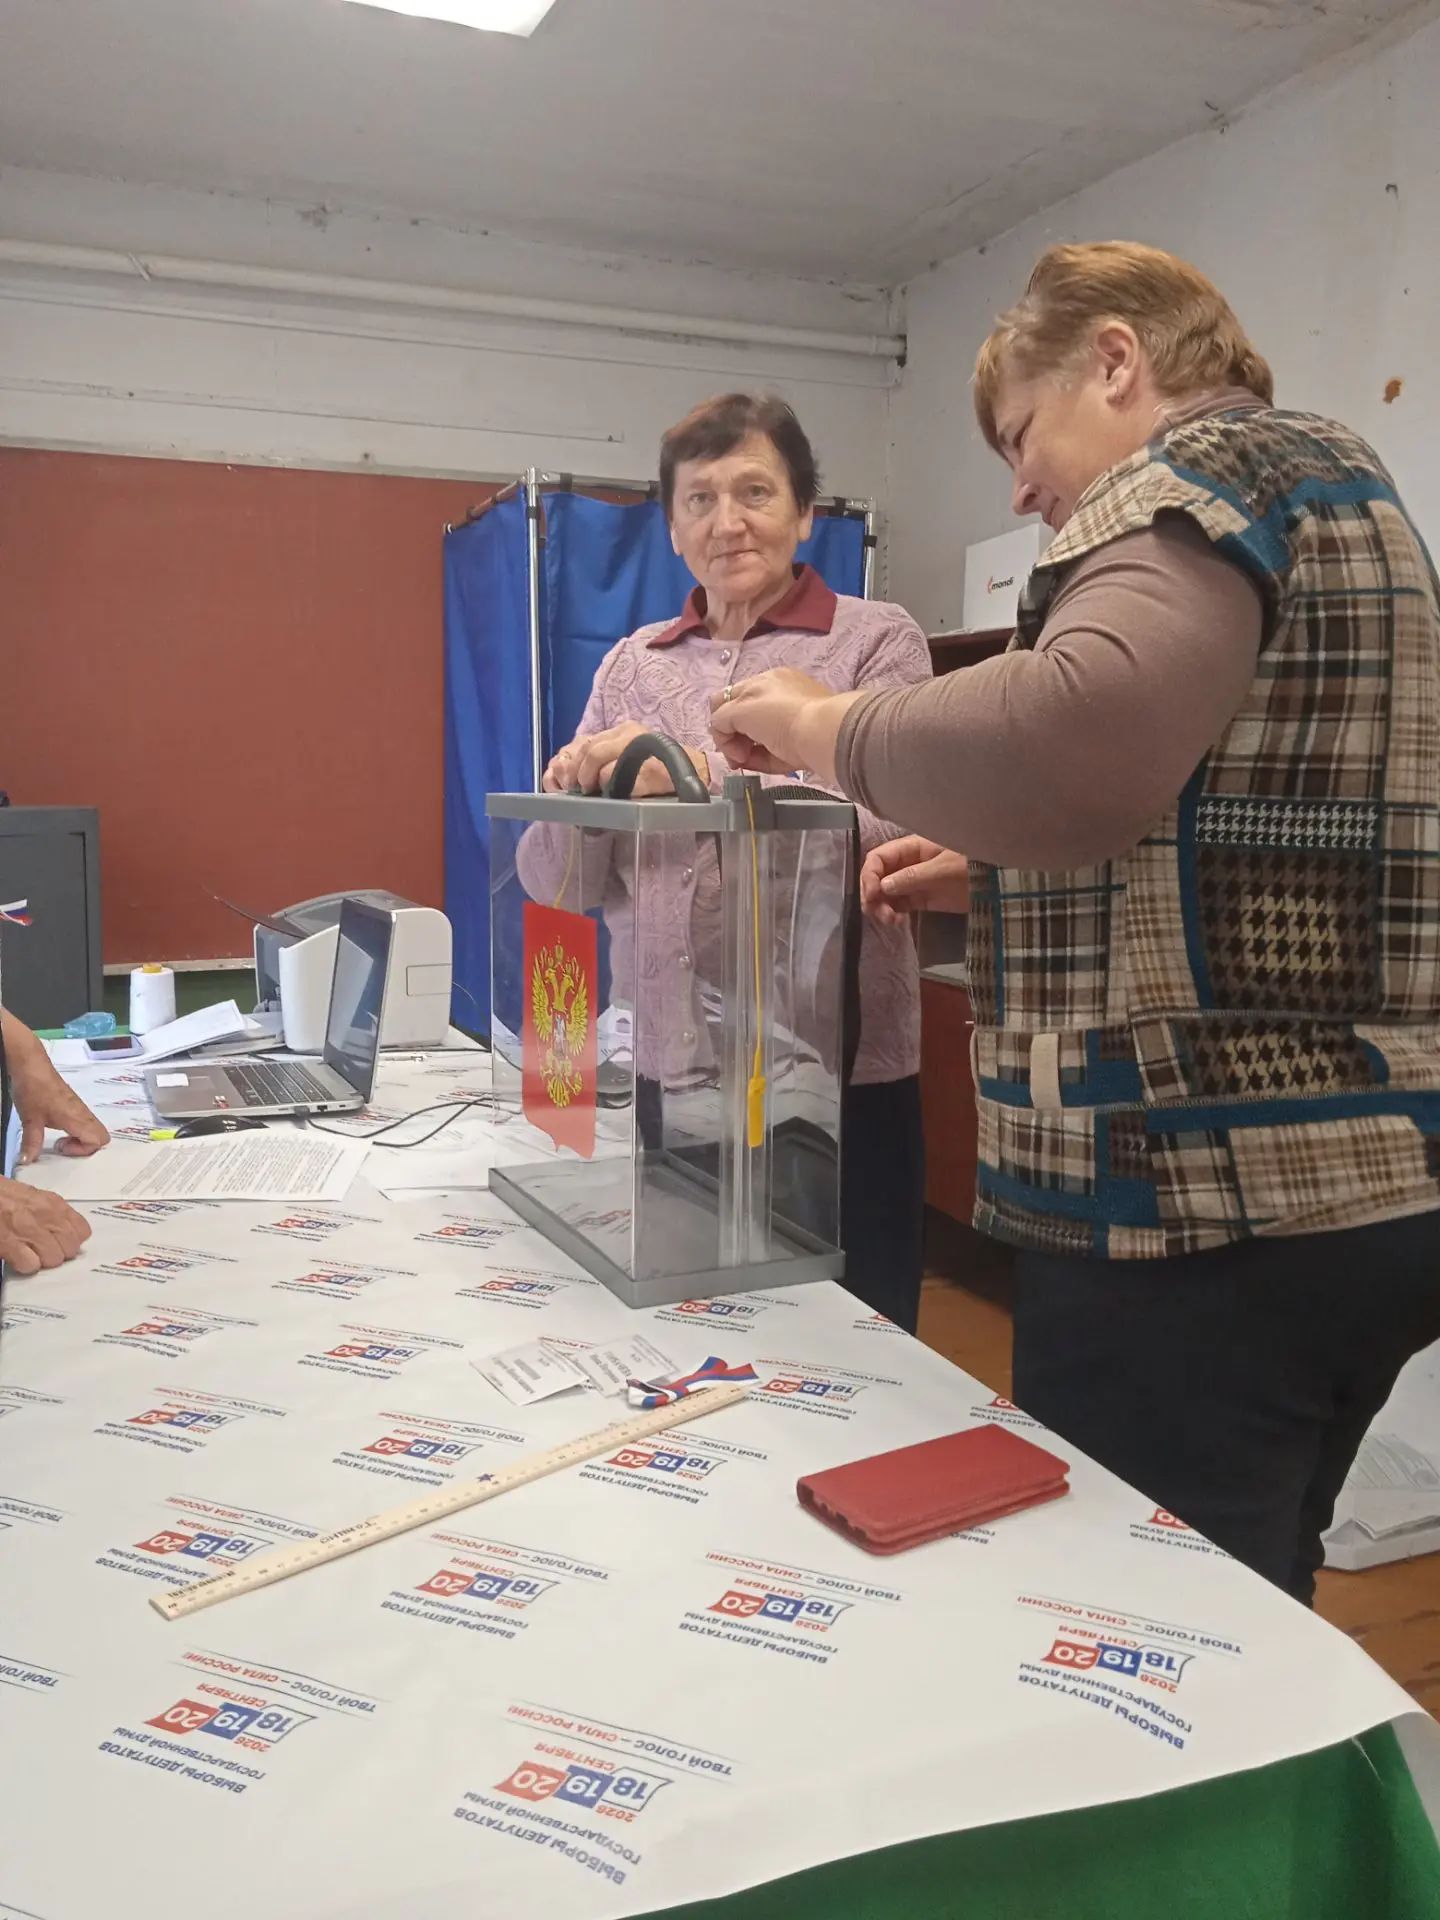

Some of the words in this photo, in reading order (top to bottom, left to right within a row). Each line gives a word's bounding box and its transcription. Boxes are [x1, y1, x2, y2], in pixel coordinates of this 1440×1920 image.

[991, 577, 1014, 590] mondi
[486, 1545, 519, 1557] СИЛА
[450, 1557, 514, 1577] СЕНТЯБРЯ
[530, 1556, 573, 1570] ГОЛОС
[766, 1566, 802, 1579] СИЛА
[574, 1566, 608, 1580] ТВОЙ
[430, 1576, 468, 1592] 20
[473, 1579, 502, 1594] 19
[510, 1580, 539, 1595] 18
[734, 1578, 804, 1598] СЕНТЯБРЯ
[816, 1578, 862, 1592] ГОЛОС
[389, 1591, 424, 1603] ДУМЫ
[864, 1588, 901, 1601] ТВОЙ
[380, 1601, 458, 1624] ДЕПУТАТОВ
[722, 1596, 760, 1613] 20
[766, 1600, 795, 1615] 19
[805, 1601, 834, 1617] 18
[1087, 1611, 1127, 1626] СИЛА
[456, 1620, 516, 1639] ВЫБОРЫ
[679, 1623, 763, 1646] ДЕПУТАТОВ
[1058, 1625, 1138, 1648] СЕНТЯБРЯ
[1145, 1624, 1196, 1641] ГОЛОС
[763, 1642, 828, 1664] ВЫБОРЫ
[1199, 1637, 1241, 1654] ТВОЙ
[182, 1653, 241, 1673] РОССИИ!
[1054, 1646, 1094, 1665] 20
[1103, 1650, 1134, 1668] 19
[1145, 1652, 1177, 1671] 18
[20, 1671, 60, 1687] ТВОЙ
[242, 1668, 279, 1682] СИЛА
[1020, 1663, 1061, 1677] ДУМЫ
[196, 1683, 267, 1707] СЕНТЯБРЯ
[290, 1681, 339, 1701] ГОЛОС
[1018, 1675, 1113, 1709] ДЕПУТАТОВ
[337, 1696, 376, 1713] ТВОЙ
[164, 1707, 209, 1728] 20
[213, 1711, 248, 1730] 19
[256, 1712, 293, 1732] 18
[508, 1706, 574, 1729] РОССИИ!
[1115, 1704, 1184, 1749] ВЫБОРЫ
[112, 1727, 152, 1743] ДУМЫ
[577, 1724, 618, 1742] СИЛА
[98, 1742, 184, 1772] ДЕПУТАТОВ
[148, 1738, 266, 1780] ГОСУДАРСТВЕННОЙ
[534, 1743, 615, 1771] СЕНТЯБРЯ
[634, 1740, 687, 1762] ГОЛОС
[688, 1756, 732, 1775] ТВОЙ
[180, 1767, 247, 1793] ВЫБОРЫ
[512, 1770, 559, 1795] 20
[566, 1775, 601, 1797] 19
[612, 1777, 648, 1800] 18
[463, 1792, 508, 1811] ДУМЫ
[454, 1808, 552, 1844] ДЕПУТАТОВ
[504, 1806, 642, 1865] ГОСУДАРСТВЕННОЙ
[549, 1839, 626, 1885] ВЫБОРЫ
